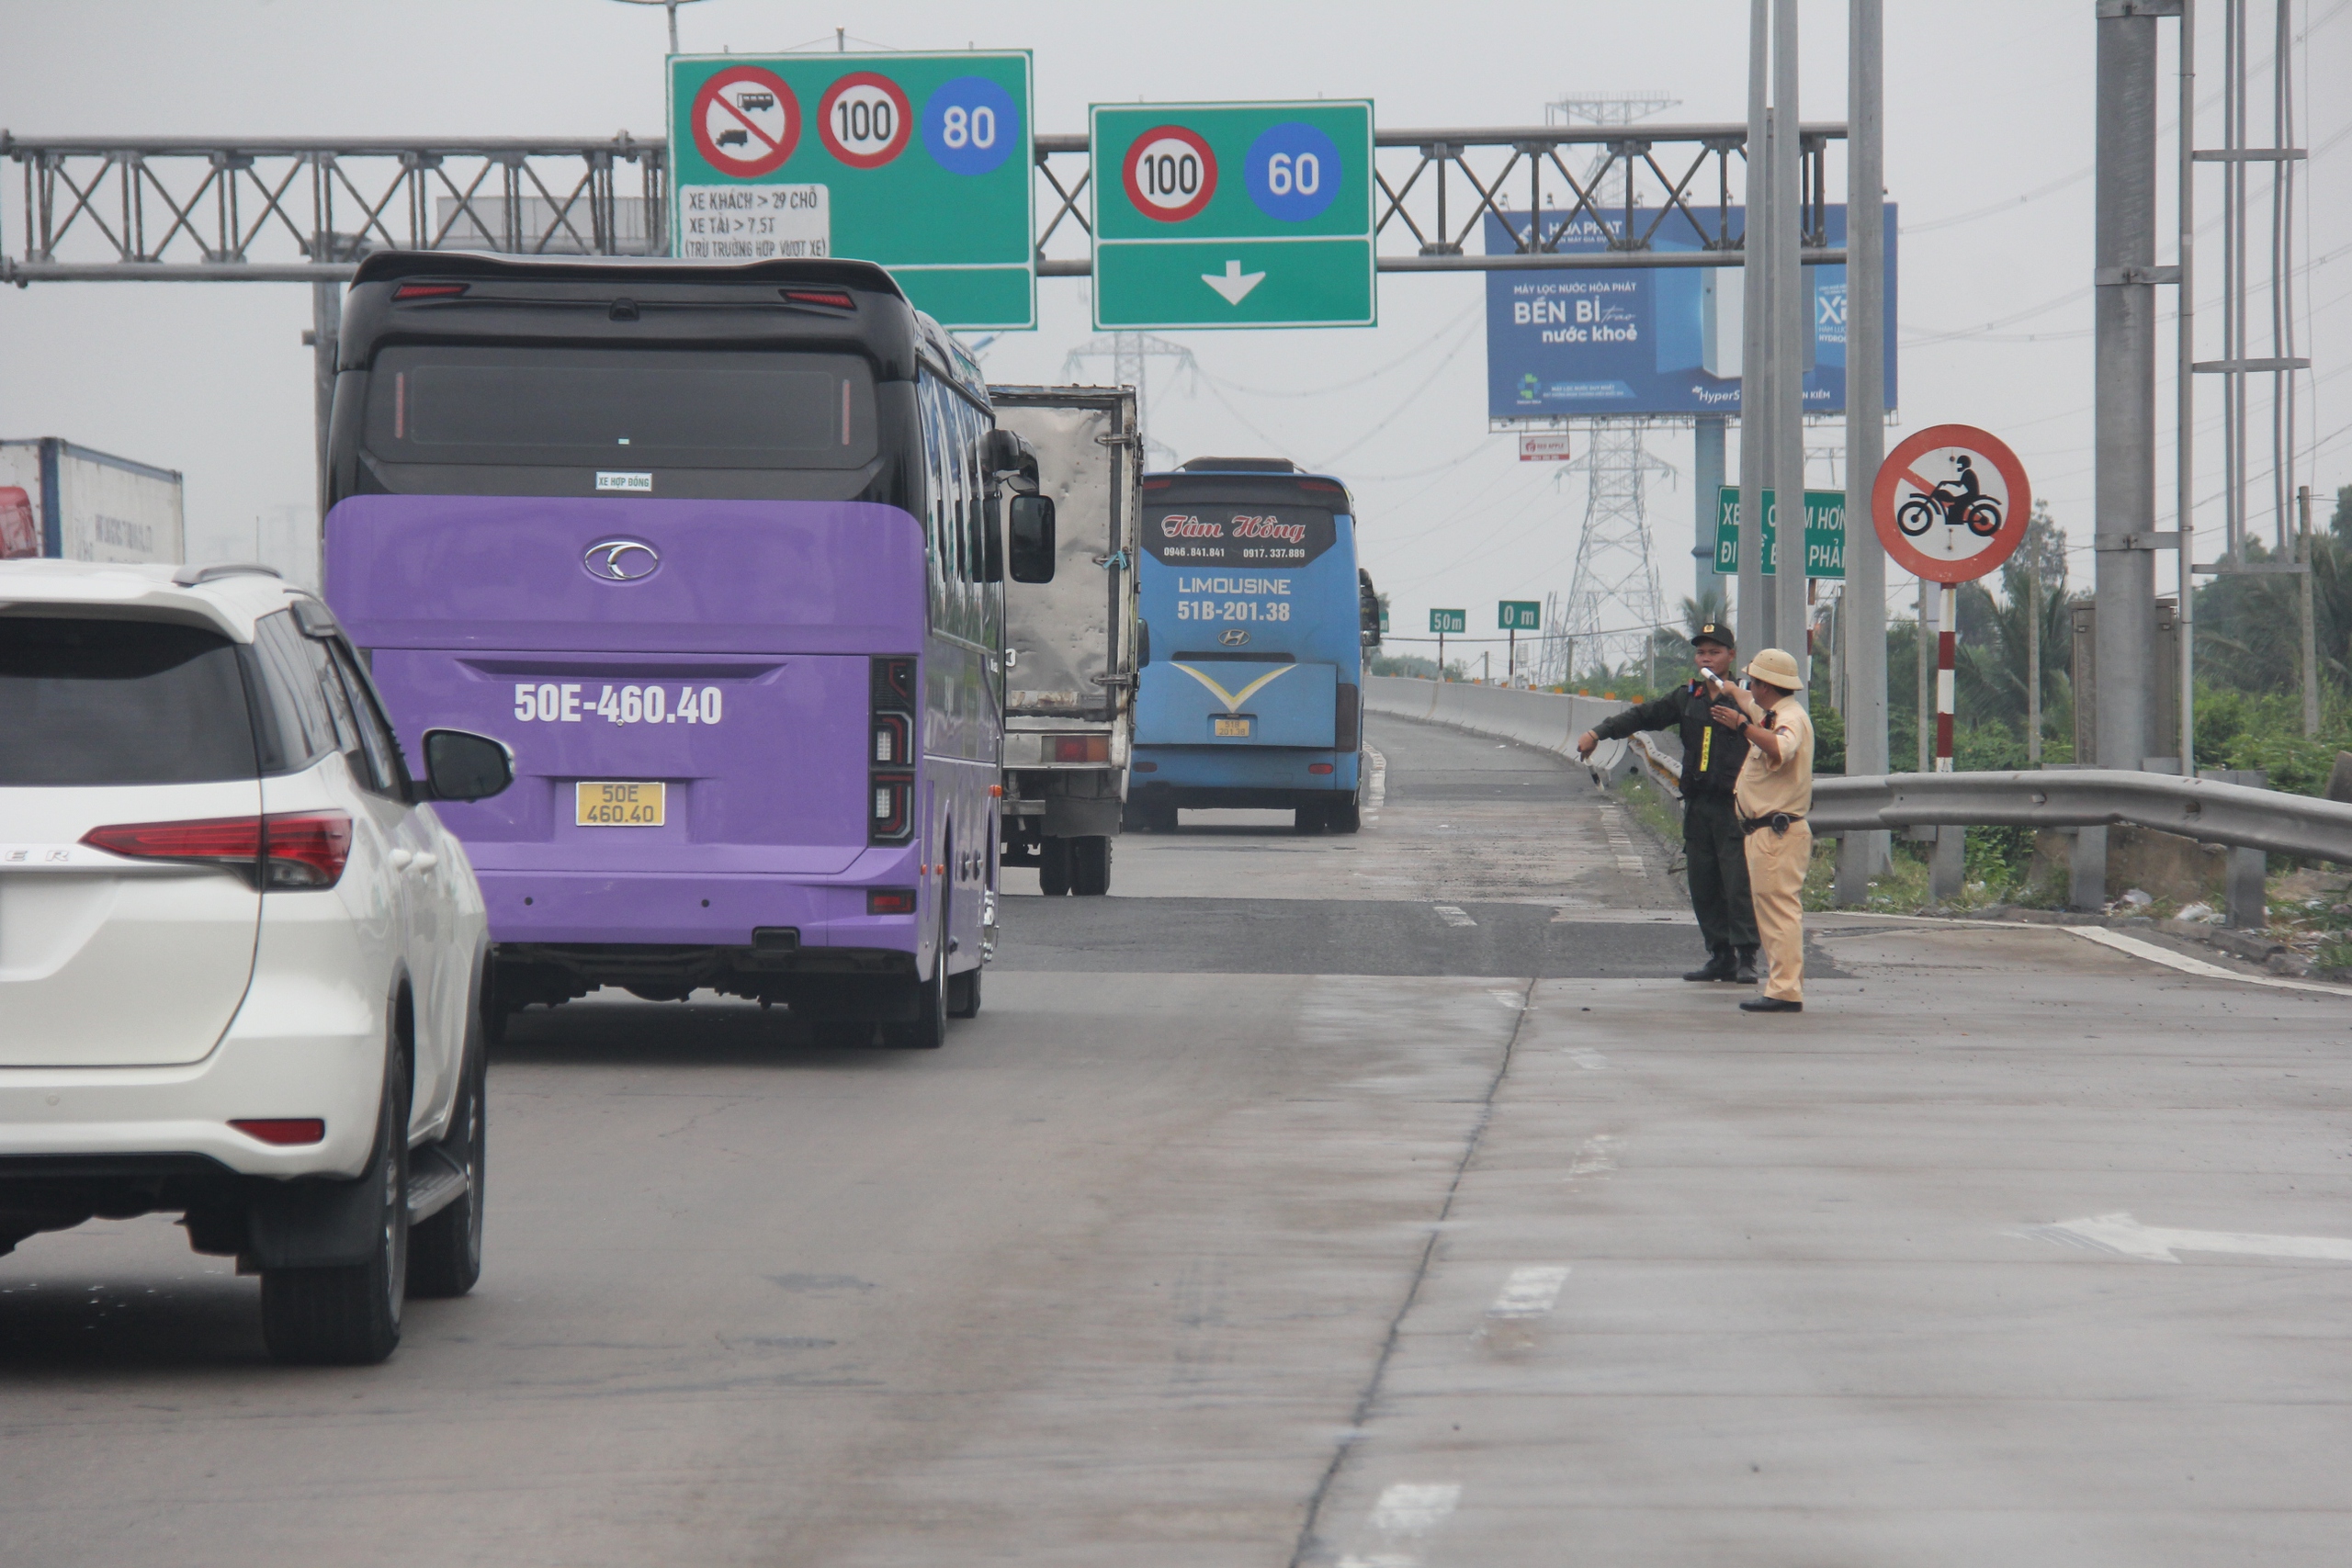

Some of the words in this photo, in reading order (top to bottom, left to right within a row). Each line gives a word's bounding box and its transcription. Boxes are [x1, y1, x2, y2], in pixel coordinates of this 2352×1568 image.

[838, 100, 891, 141] 100
[943, 105, 995, 149] 80
[1144, 153, 1197, 195] 100
[1268, 152, 1319, 196] 60
[689, 193, 705, 209] XE
[709, 188, 753, 209] KHÁCH
[772, 191, 786, 209] 29
[790, 186, 817, 209] CHỖ
[689, 217, 705, 233] XE
[1514, 283, 1534, 294] MÁY
[1612, 281, 1636, 292] PHÁT
[1543, 326, 1588, 343] nước
[599, 477, 608, 486] XE
[1161, 514, 1224, 538] Tâm
[1231, 514, 1306, 544] Hồng
[1721, 540, 1736, 563] ĐI
[1179, 577, 1291, 595] LIMOUSINE
[1177, 601, 1290, 622] 51B-201.38
[1434, 613, 1462, 630] 50m
[1504, 605, 1514, 625] 0
[1521, 610, 1533, 625] m
[514, 683, 722, 725] 50E-460.40
[602, 784, 639, 803] 50E
[587, 805, 654, 823] 460.40
